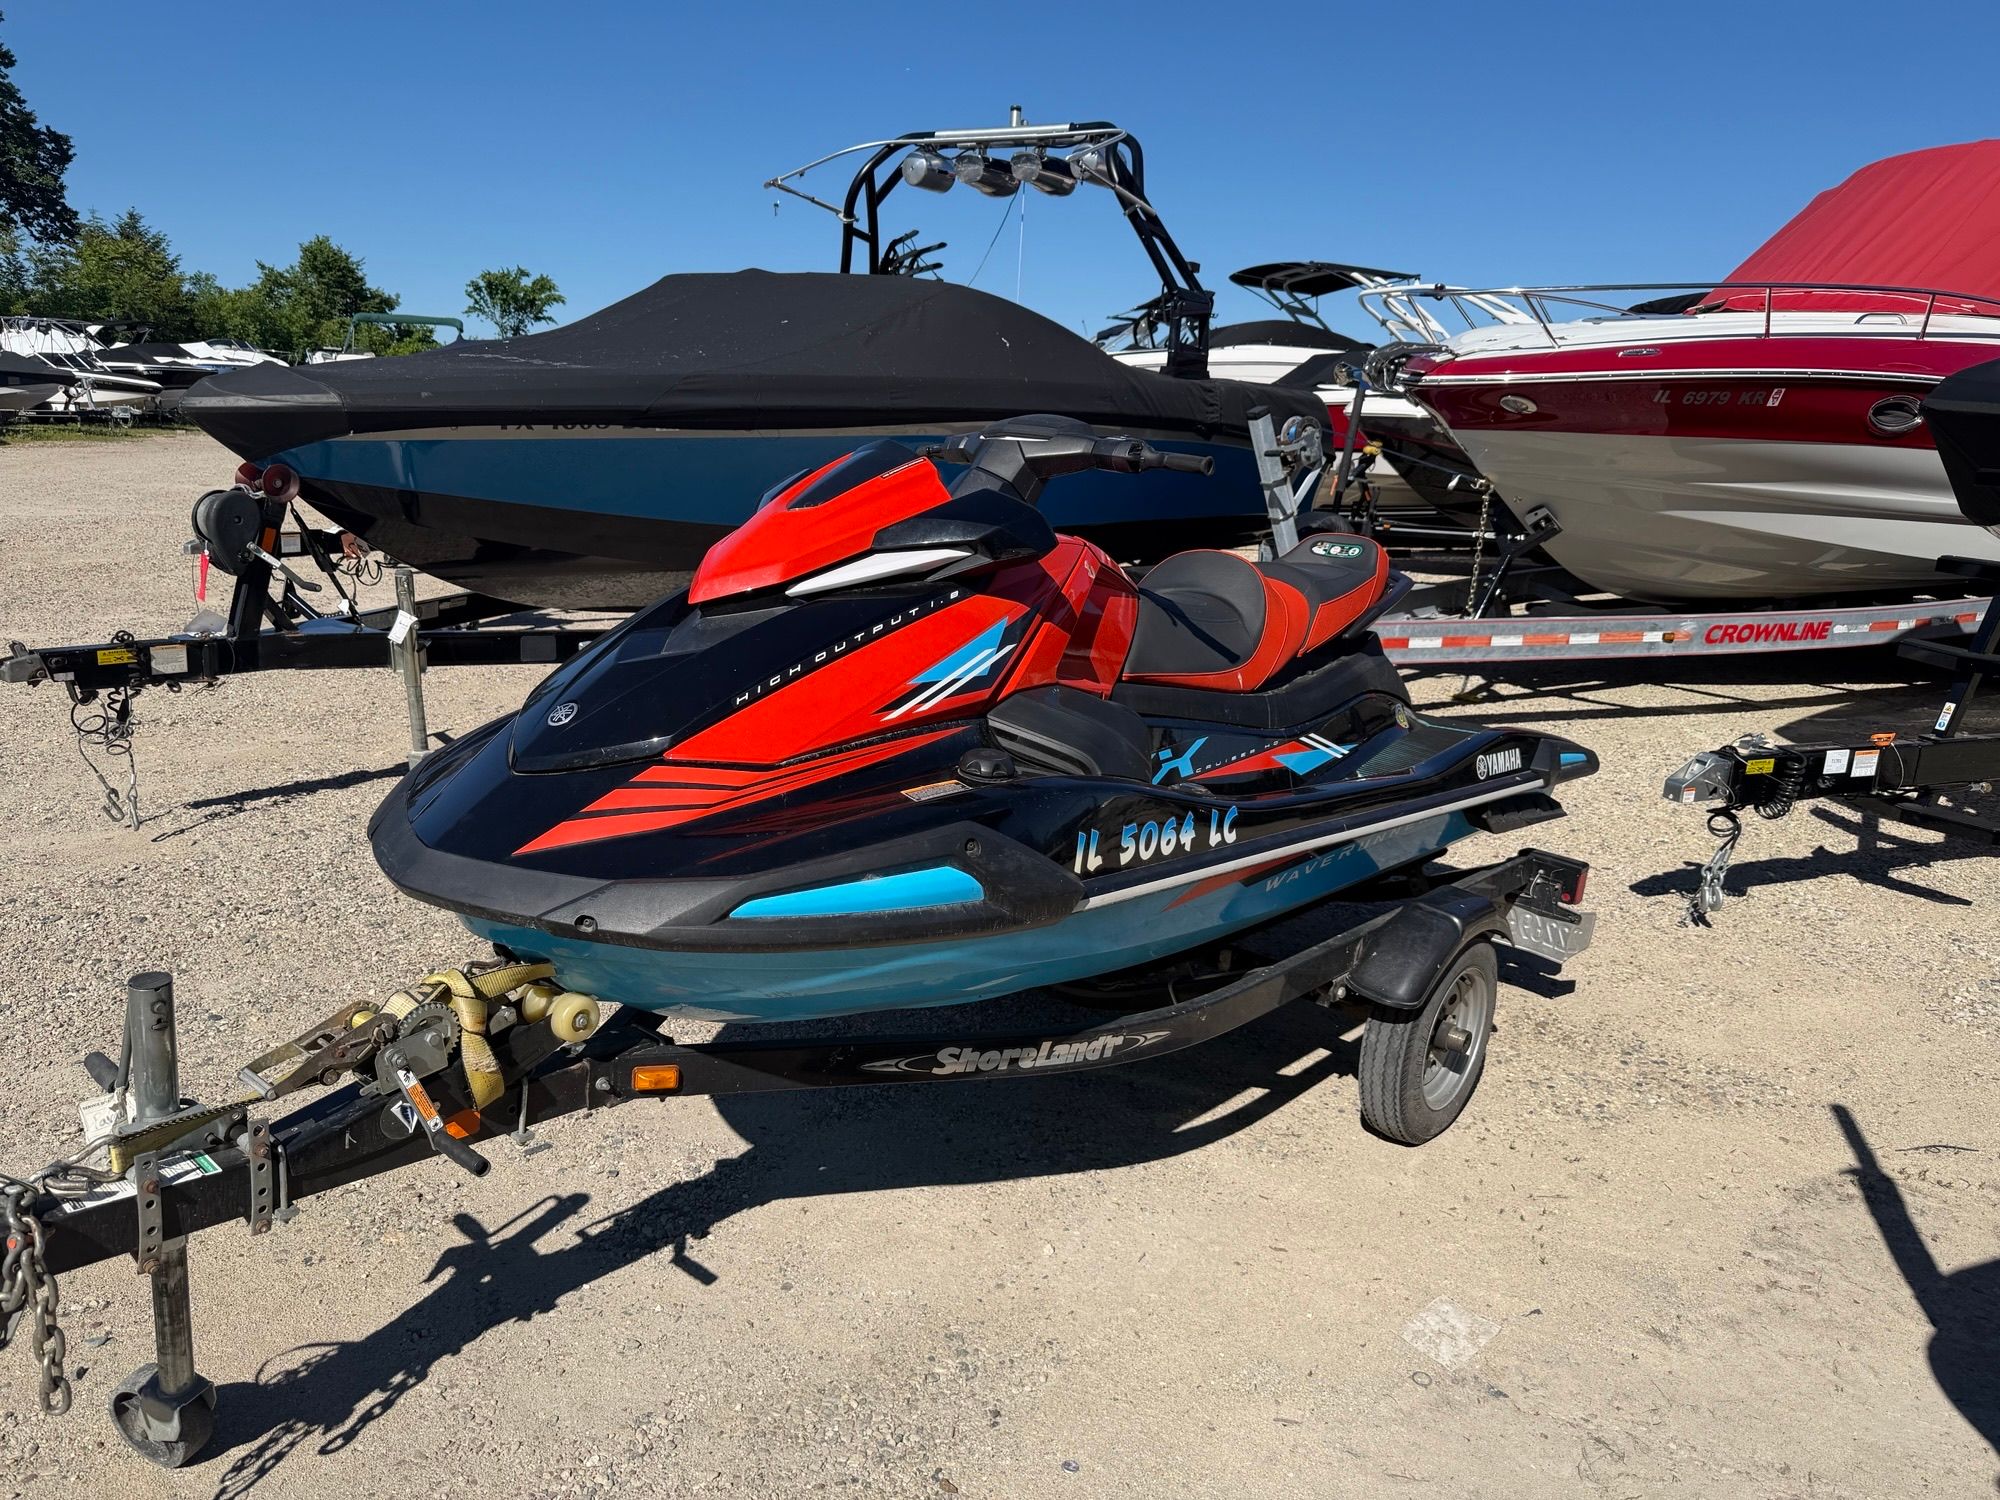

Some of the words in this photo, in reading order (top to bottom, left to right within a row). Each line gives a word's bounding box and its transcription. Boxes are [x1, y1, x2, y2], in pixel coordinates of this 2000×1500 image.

[1652, 389, 1672, 403] IL
[1682, 391, 1731, 405] 6979
[1737, 391, 1767, 405] KR
[1704, 621, 1833, 644] CROWNLINE
[736, 663, 801, 705] HIGH
[815, 607, 919, 662] OUTPUT
[931, 590, 959, 608] 1.8
[1195, 748, 1256, 773] CRUISER
[1486, 747, 1522, 776] YAMAHA
[1073, 828, 1103, 874] IL
[1119, 810, 1196, 866] 5064
[1208, 805, 1239, 847] LC
